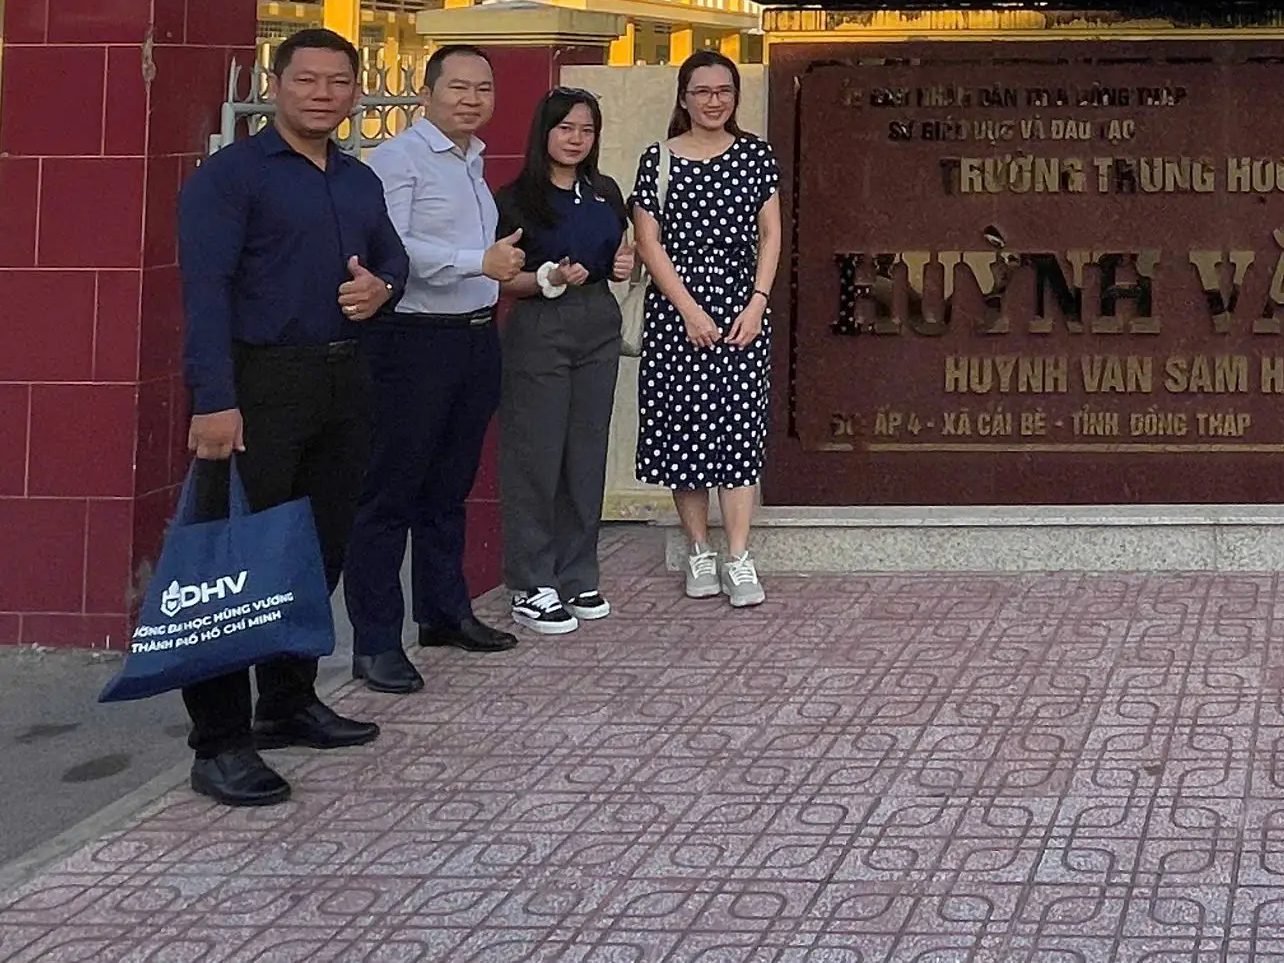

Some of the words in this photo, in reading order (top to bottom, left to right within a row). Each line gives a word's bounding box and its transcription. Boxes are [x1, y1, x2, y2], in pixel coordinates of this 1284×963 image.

[1094, 156, 1215, 194] TRUNG
[831, 225, 1162, 336] HUỲNH
[944, 355, 1067, 394] HUYNH
[1081, 355, 1153, 394] VAN
[1164, 355, 1249, 394] SAM
[907, 412, 922, 436] 4
[181, 571, 248, 608] DHV
[248, 610, 282, 628] MINH
